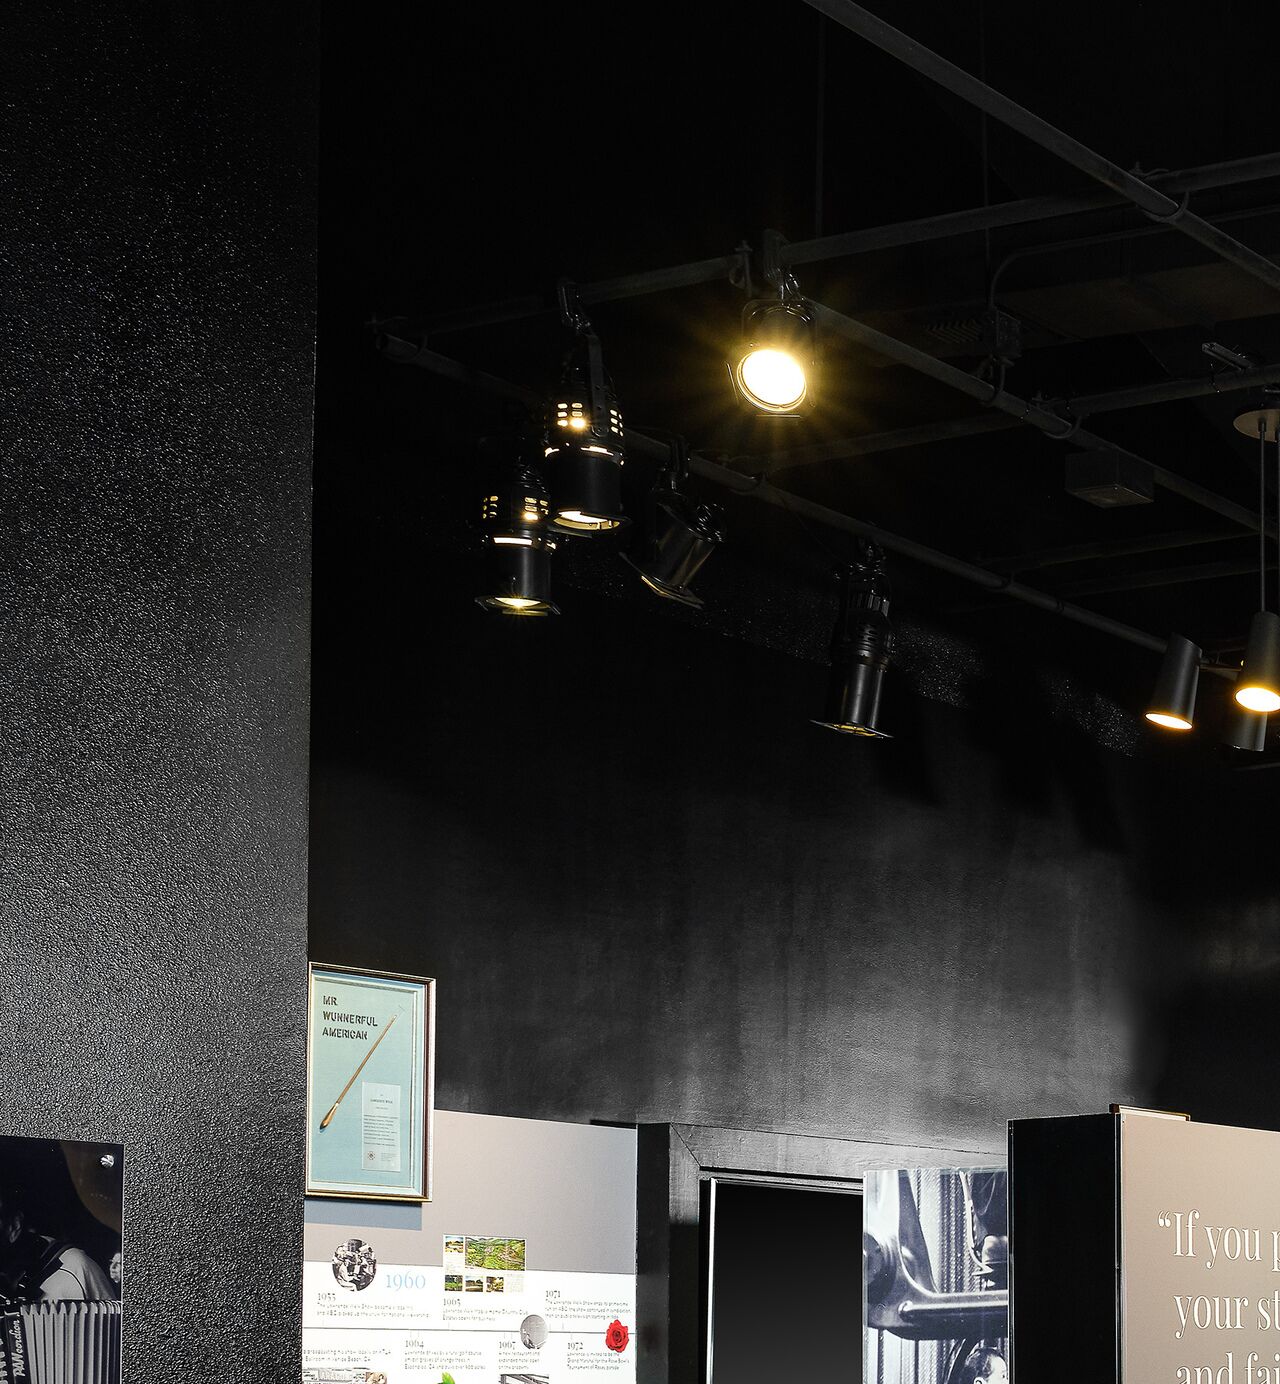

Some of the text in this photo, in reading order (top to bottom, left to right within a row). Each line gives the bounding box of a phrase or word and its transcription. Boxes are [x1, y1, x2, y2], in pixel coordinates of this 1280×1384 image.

[323, 1011, 378, 1026] WUNNERFUL
[322, 1027, 367, 1040] AMERICAN
[1158, 1210, 1200, 1257] “If
[1204, 1226, 1262, 1269] you
[386, 1274, 426, 1292] 1960
[1173, 1295, 1249, 1339] your
